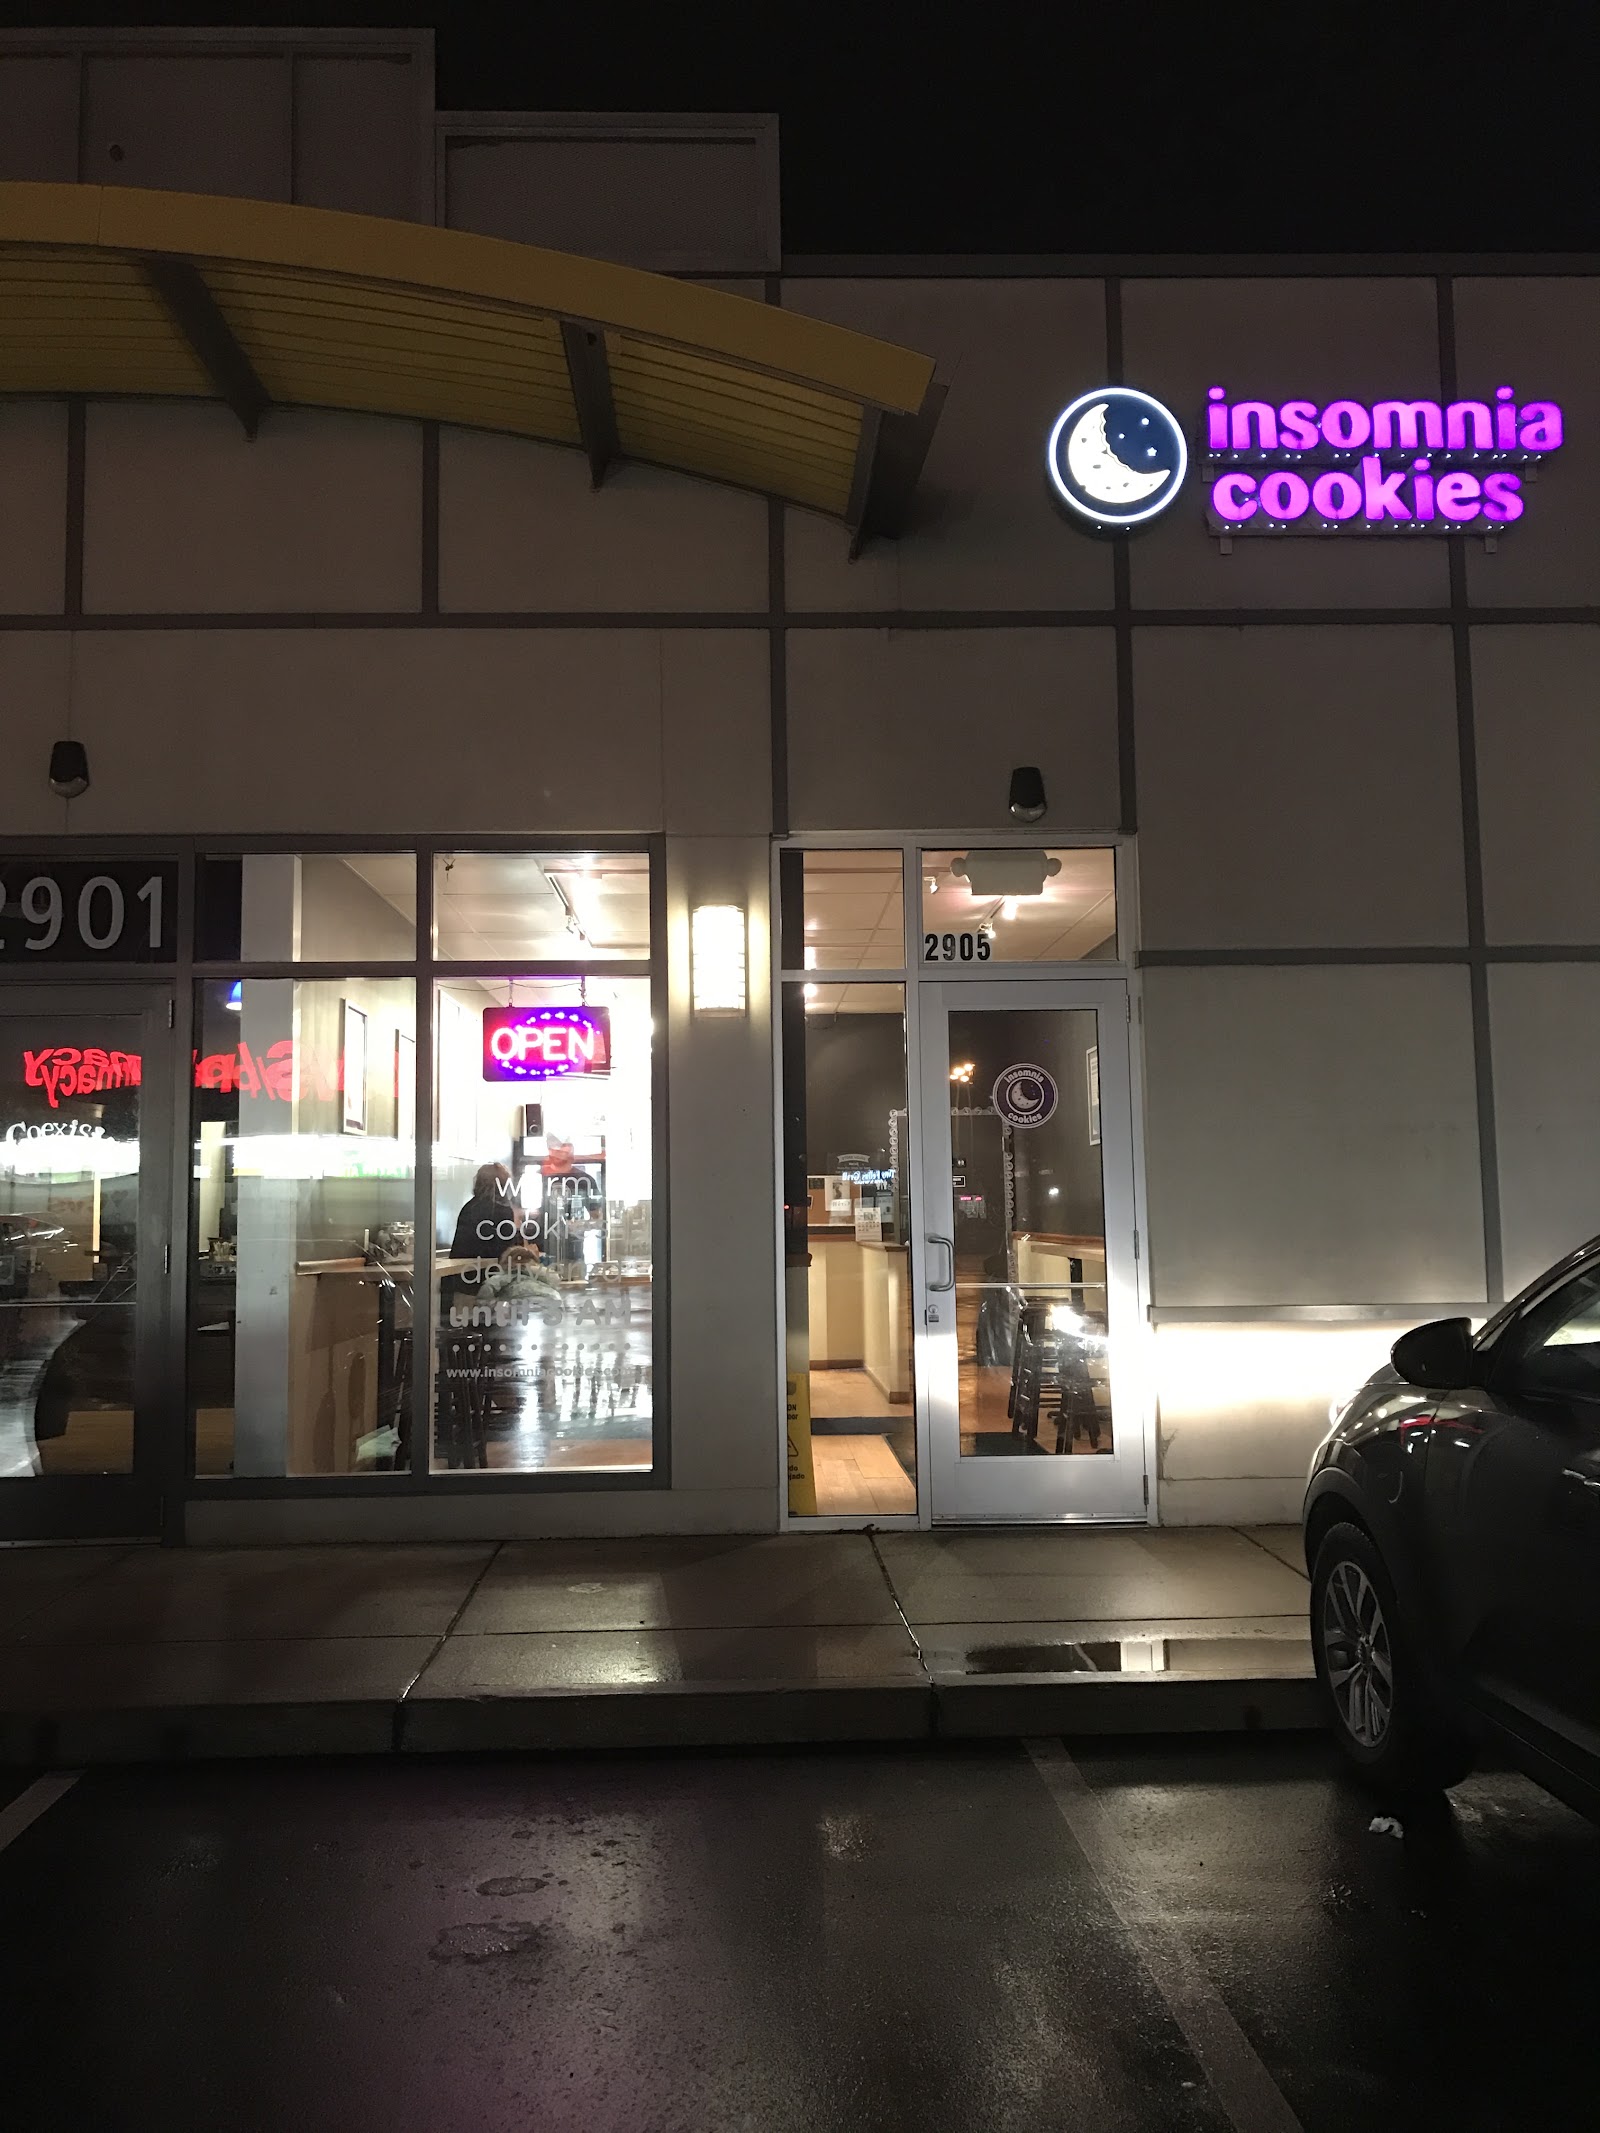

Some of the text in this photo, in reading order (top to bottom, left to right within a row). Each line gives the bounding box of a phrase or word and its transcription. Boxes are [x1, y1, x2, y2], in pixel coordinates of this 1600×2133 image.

[1208, 386, 1563, 451] insomnia
[1213, 456, 1525, 521] cookies
[925, 933, 991, 961] 2905
[491, 1027, 594, 1061] OPEN
[1004, 1069, 1045, 1083] insomnia
[1008, 1112, 1042, 1123] cookies
[495, 1175, 592, 1197] wrm
[450, 1300, 530, 1327] until
[576, 1299, 632, 1326] AM
